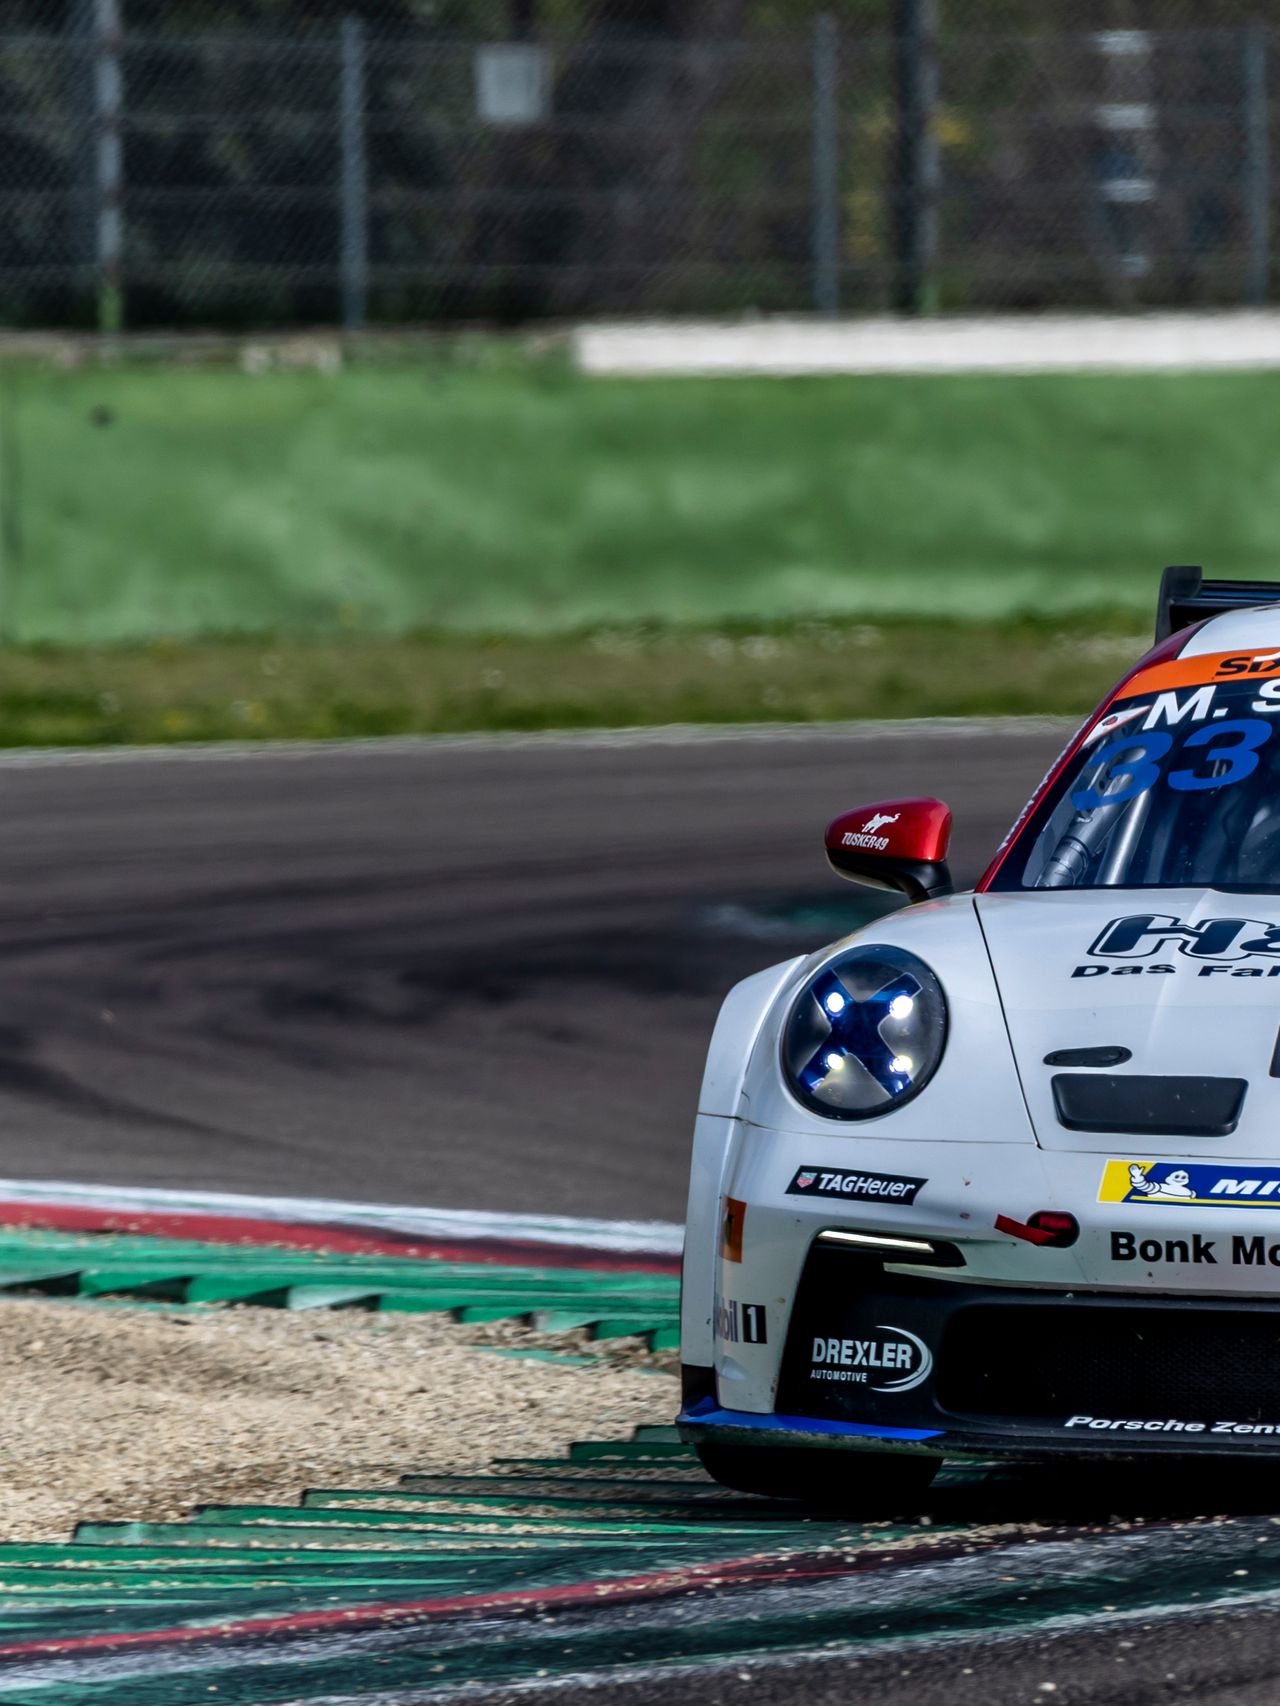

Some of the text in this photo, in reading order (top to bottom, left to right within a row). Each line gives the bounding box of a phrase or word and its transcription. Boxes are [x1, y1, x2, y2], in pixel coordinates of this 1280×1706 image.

[1142, 684, 1228, 731] M.
[1072, 718, 1273, 811] 33
[841, 832, 890, 850] TUSKER49
[1070, 963, 1178, 979] Das
[1110, 1231, 1218, 1265] Bonk
[811, 1336, 913, 1369] DREXLER
[810, 1369, 868, 1383] AUTOMOTIVE
[1063, 1415, 1207, 1433] Porsche
